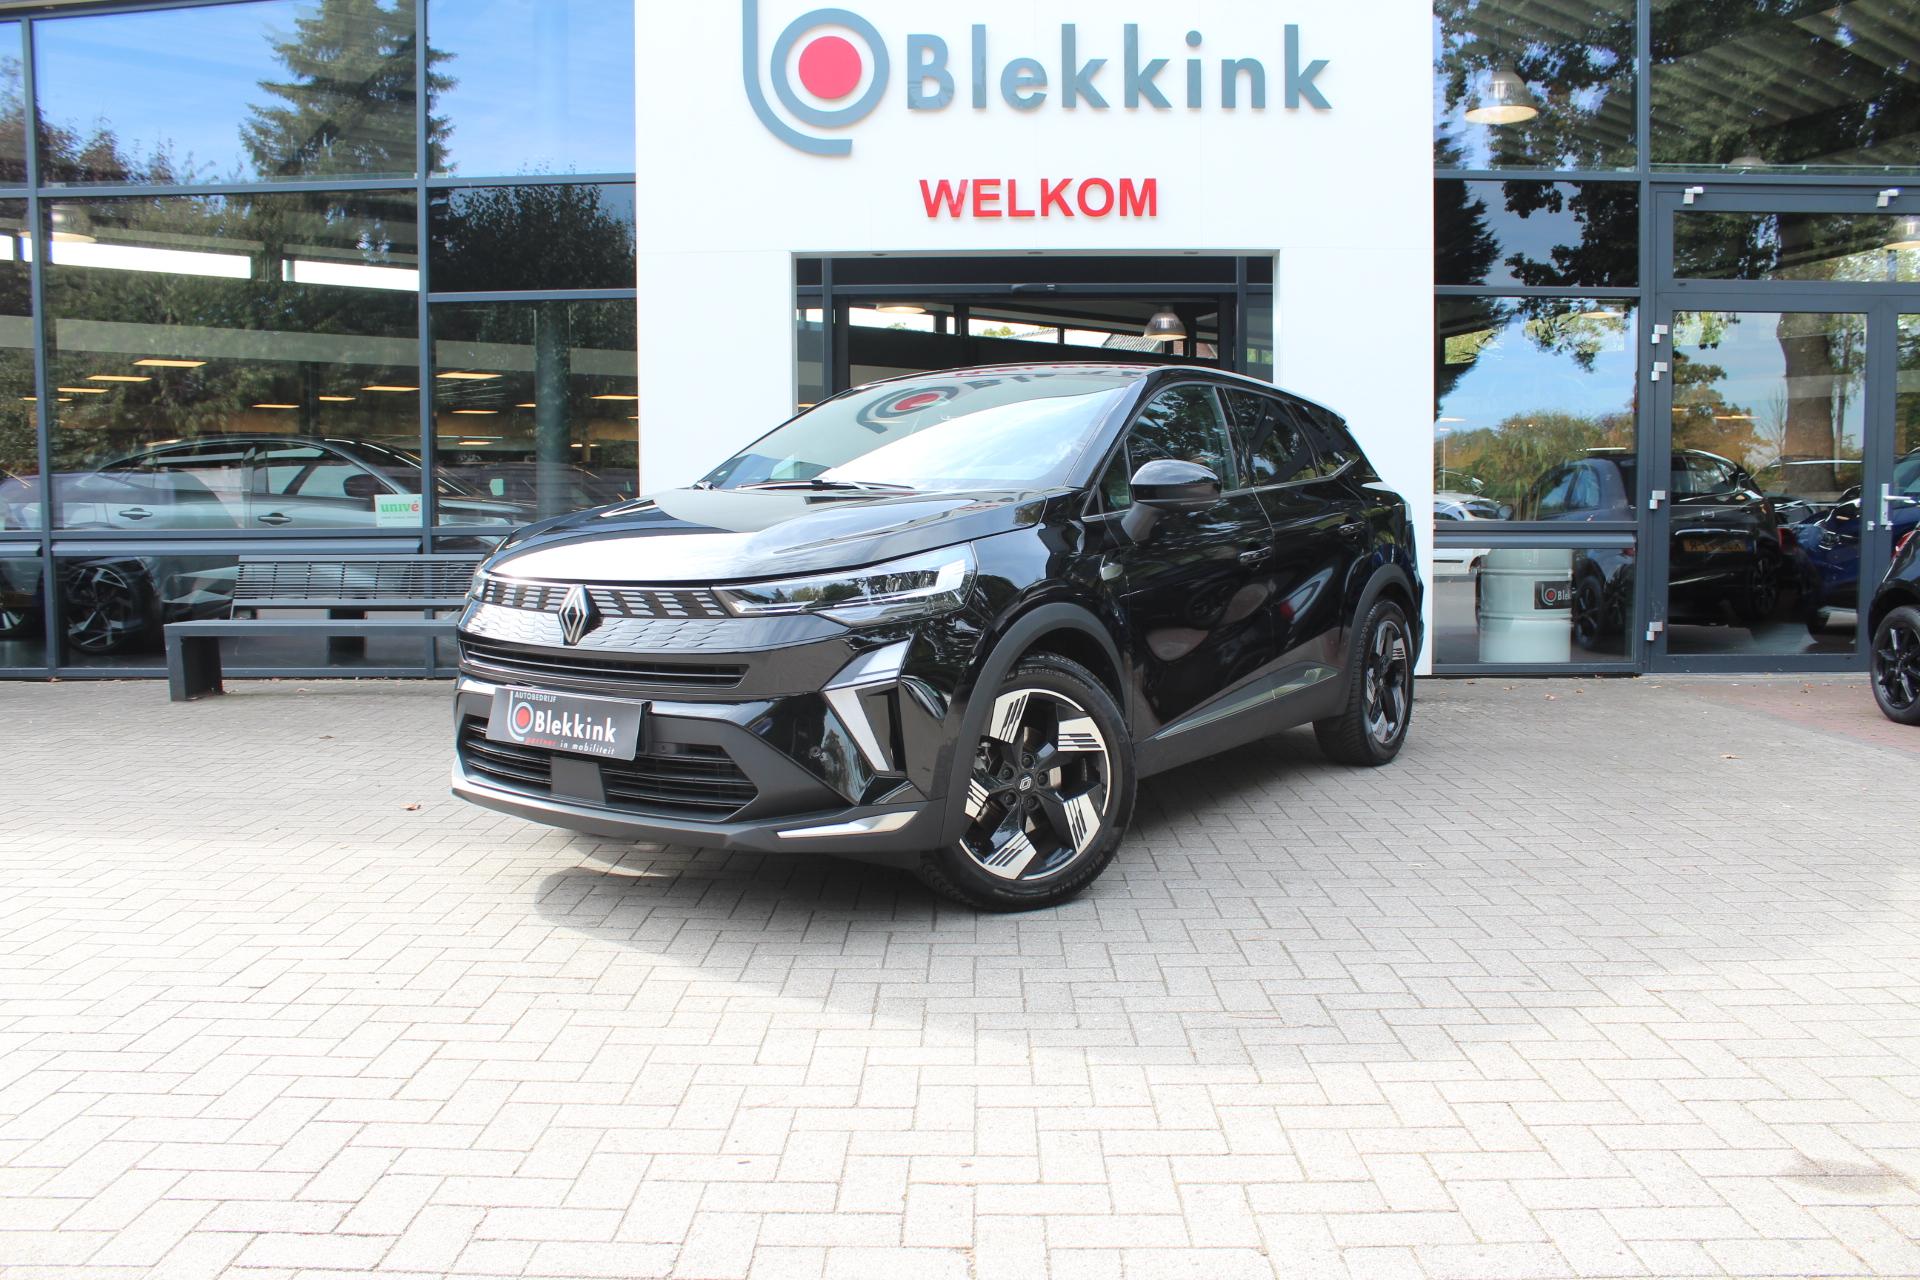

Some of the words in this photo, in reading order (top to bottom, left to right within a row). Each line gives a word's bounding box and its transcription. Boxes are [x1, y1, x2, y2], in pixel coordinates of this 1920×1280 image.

[907, 24, 1332, 110] Blekkink
[919, 178, 1157, 217] WELKOM
[515, 691, 556, 702] AUTOBEDRIJF
[535, 709, 617, 743] Blekkink
[560, 740, 568, 749] in
[572, 742, 615, 755] mobiliteit
